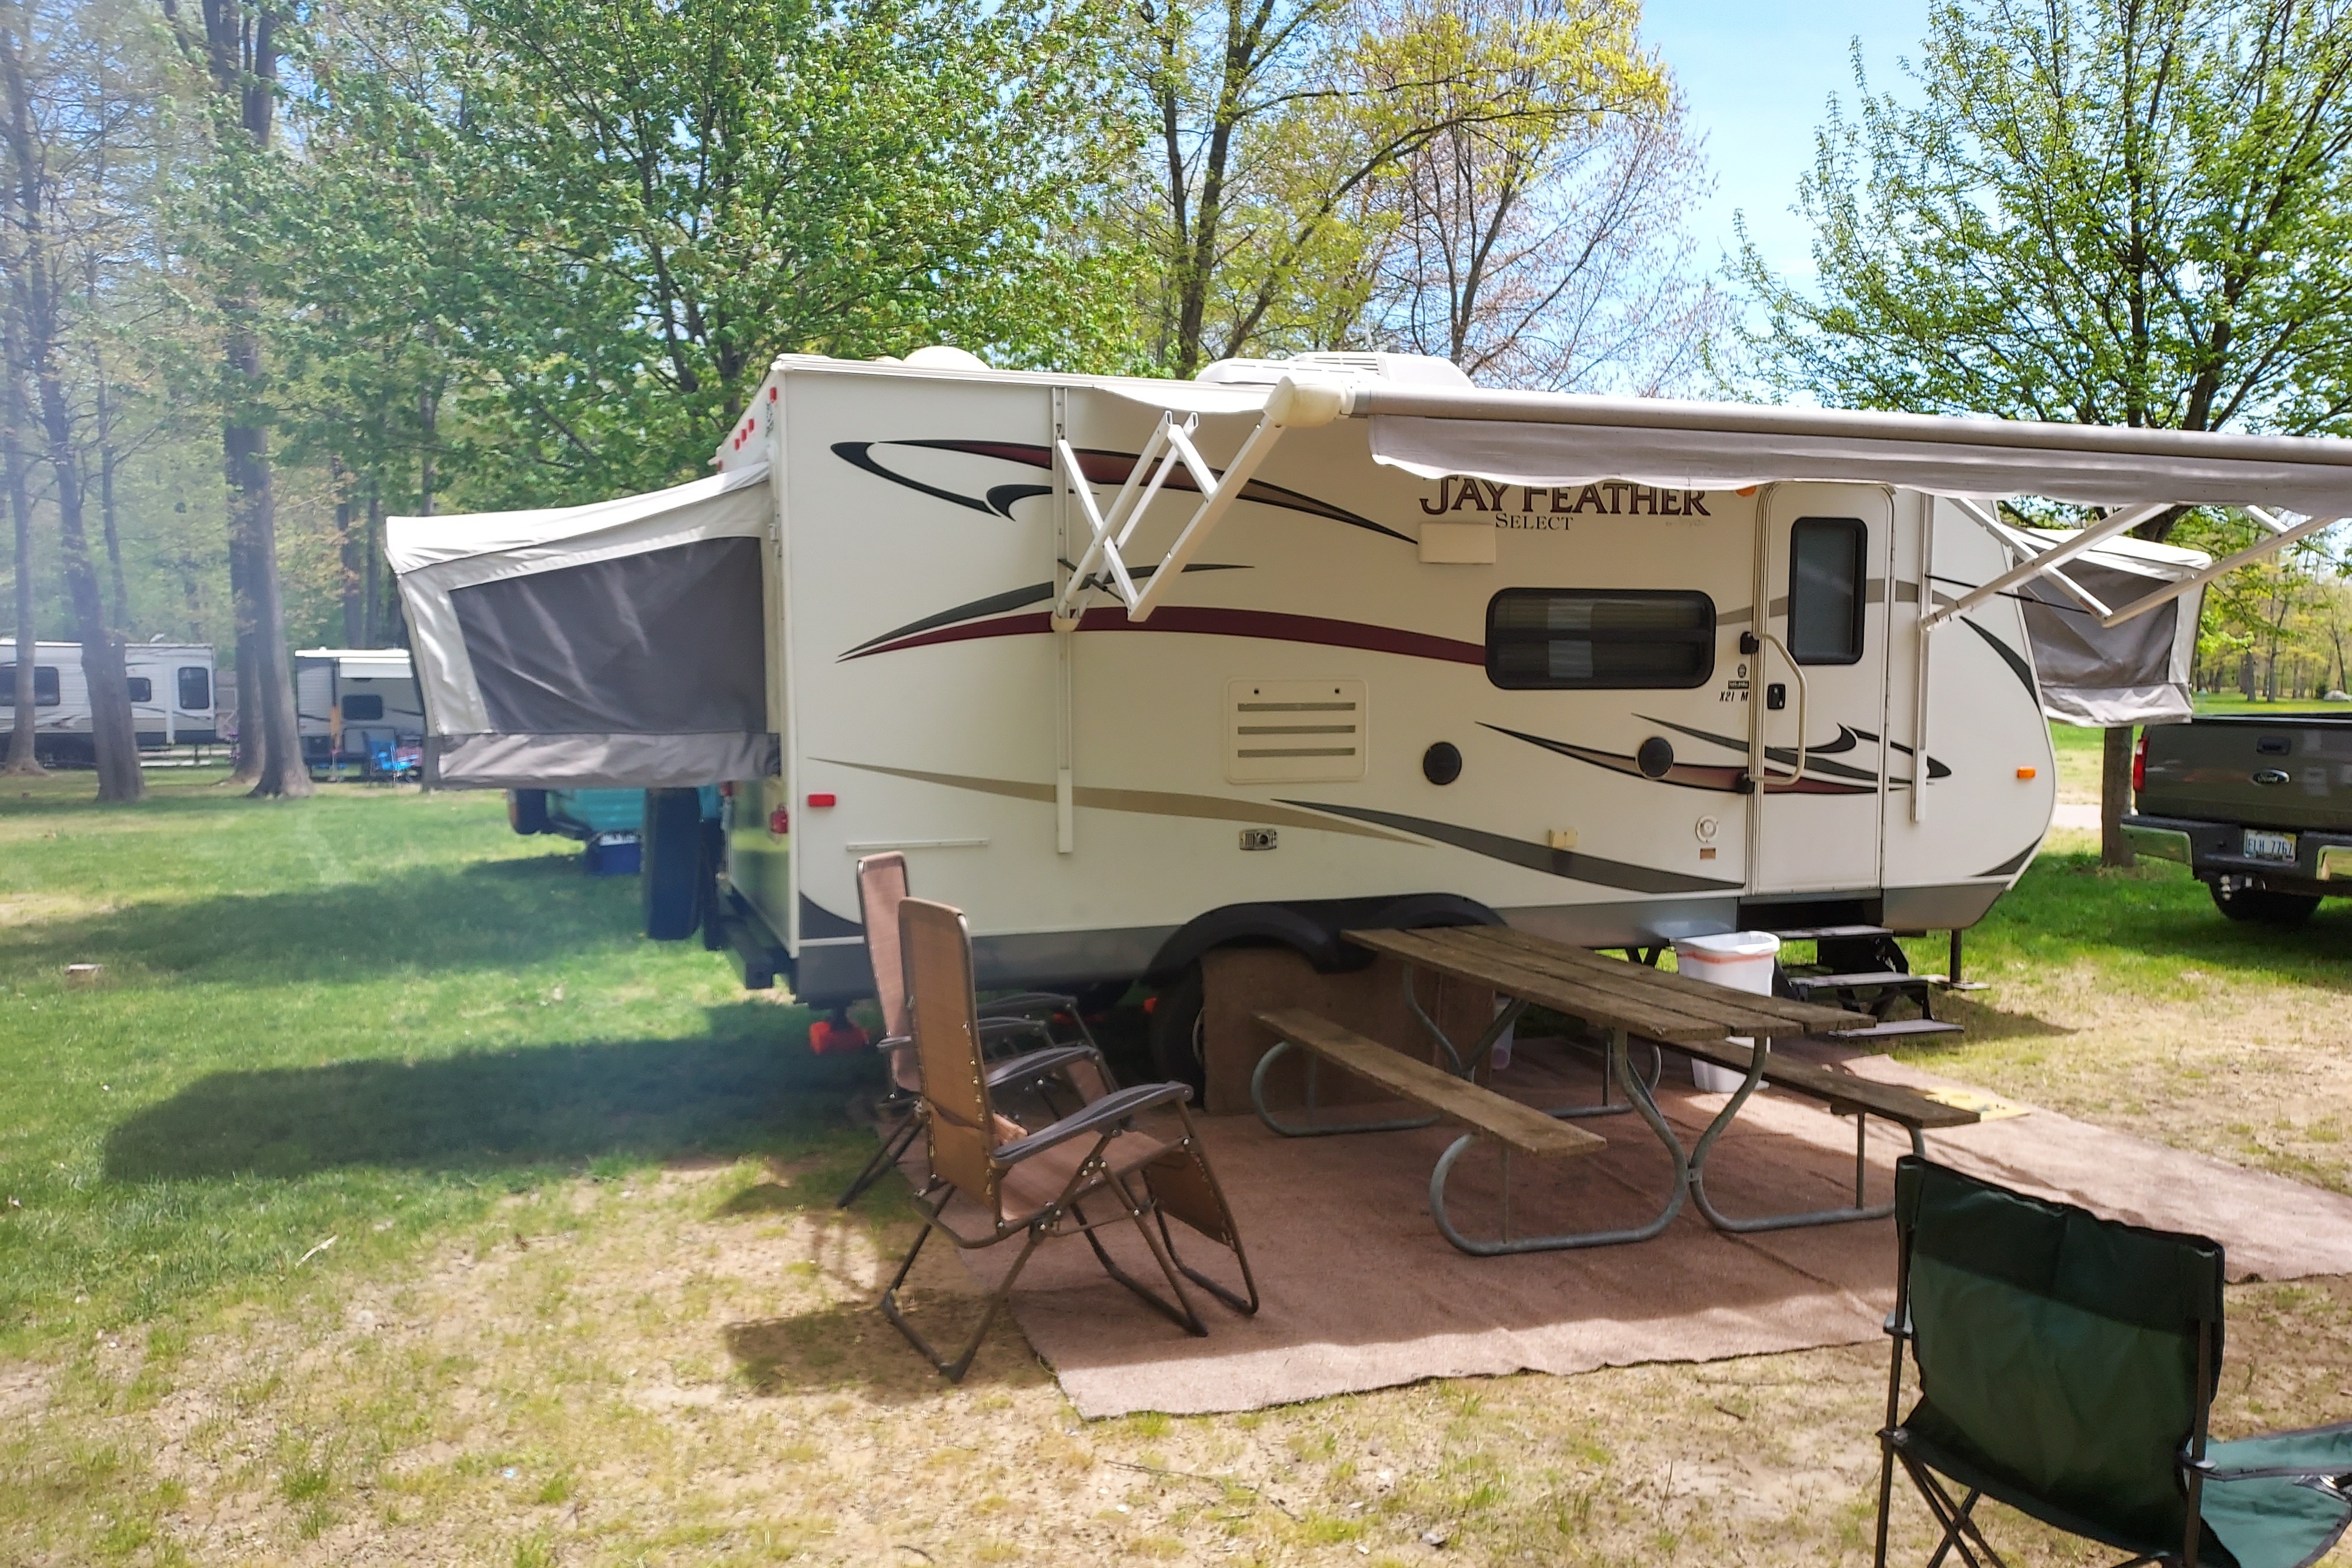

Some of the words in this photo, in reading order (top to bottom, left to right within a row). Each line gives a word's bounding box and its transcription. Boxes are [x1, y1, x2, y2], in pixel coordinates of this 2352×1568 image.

[1419, 474, 1511, 516] JAY
[1522, 483, 1711, 516] FEATHER
[1495, 513, 1573, 530] SELECT
[1719, 690, 1735, 702] X21
